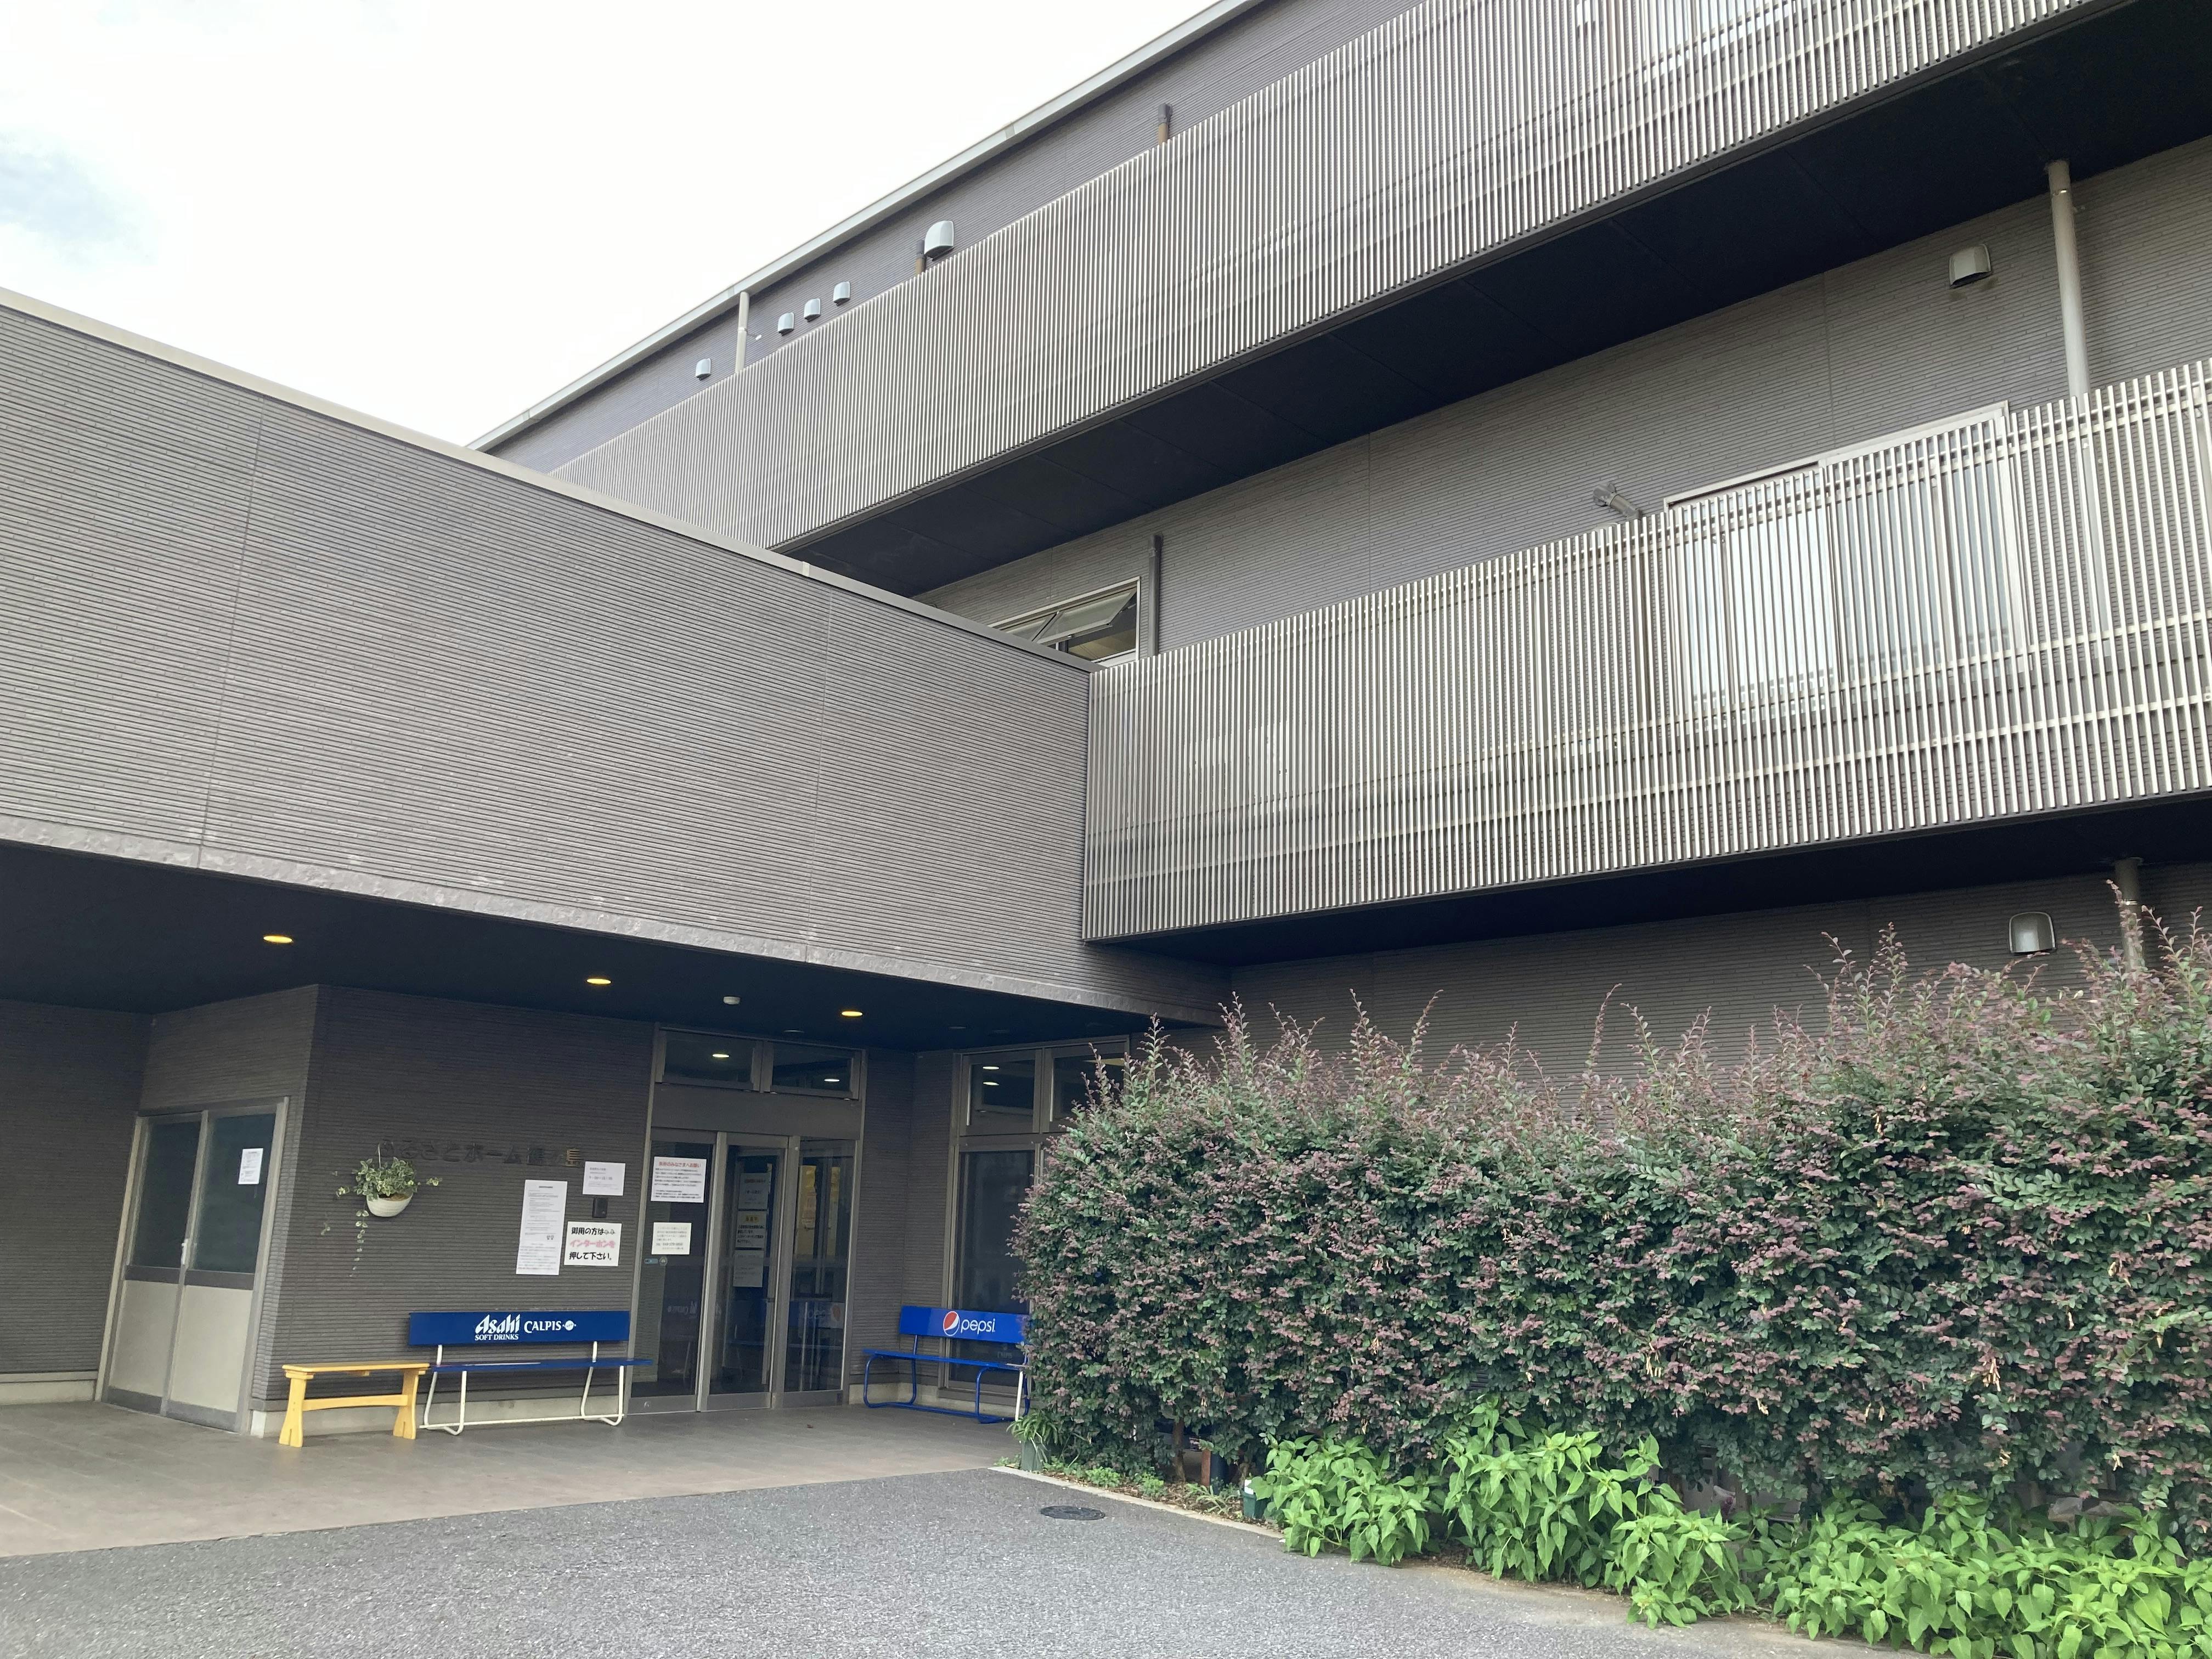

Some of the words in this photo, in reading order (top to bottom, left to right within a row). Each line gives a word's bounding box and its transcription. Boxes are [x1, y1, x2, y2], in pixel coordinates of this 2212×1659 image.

[571, 1227, 604, 1235] 御用の方は
[570, 1239, 616, 1249] インターホンを
[569, 1251, 612, 1260] 押して下さい。
[475, 1314, 521, 1334] Asahi
[524, 1321, 562, 1334] CALPIS
[960, 1318, 996, 1335] pepsi
